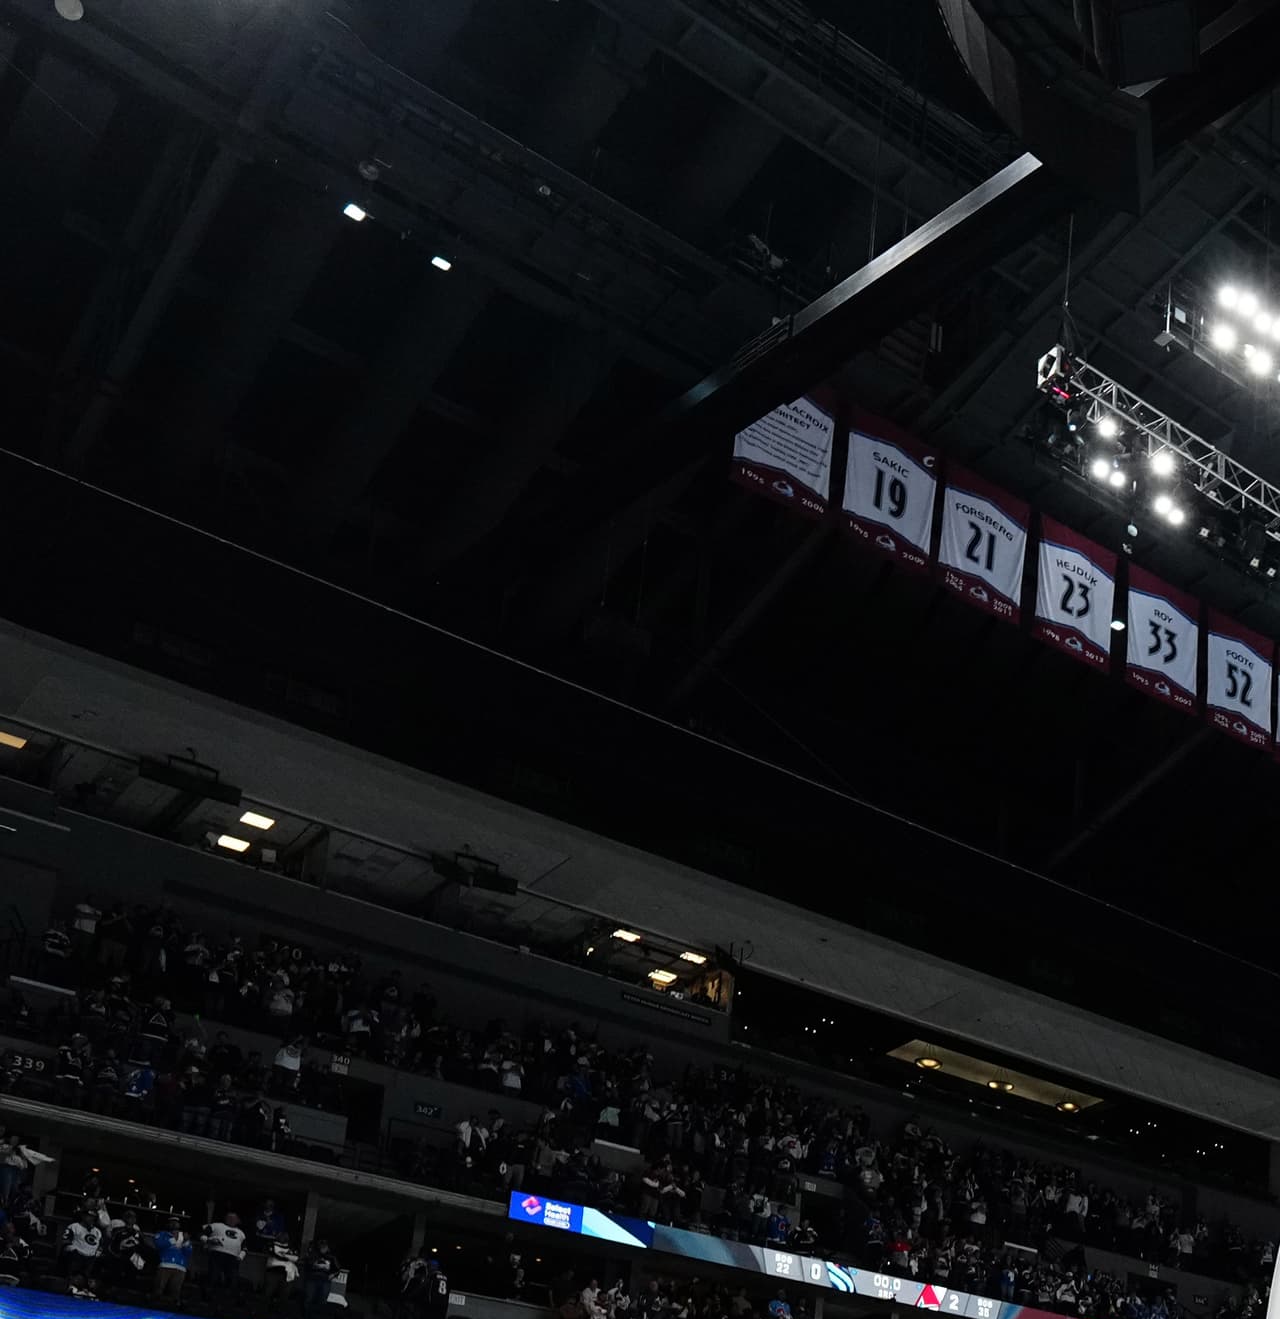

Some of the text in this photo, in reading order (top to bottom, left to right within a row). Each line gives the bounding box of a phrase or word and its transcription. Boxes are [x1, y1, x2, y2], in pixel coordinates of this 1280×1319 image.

[872, 451, 910, 478] SAKIC
[872, 466, 906, 518] 19
[955, 501, 1014, 541] FORSBERG
[966, 519, 996, 572] 21
[1055, 558, 1098, 587] HEJDUK
[1061, 574, 1090, 617] 23
[1154, 608, 1173, 624] ROY
[1148, 619, 1177, 664] 33
[1225, 649, 1254, 669] FOOTE
[1225, 663, 1253, 707] 52
